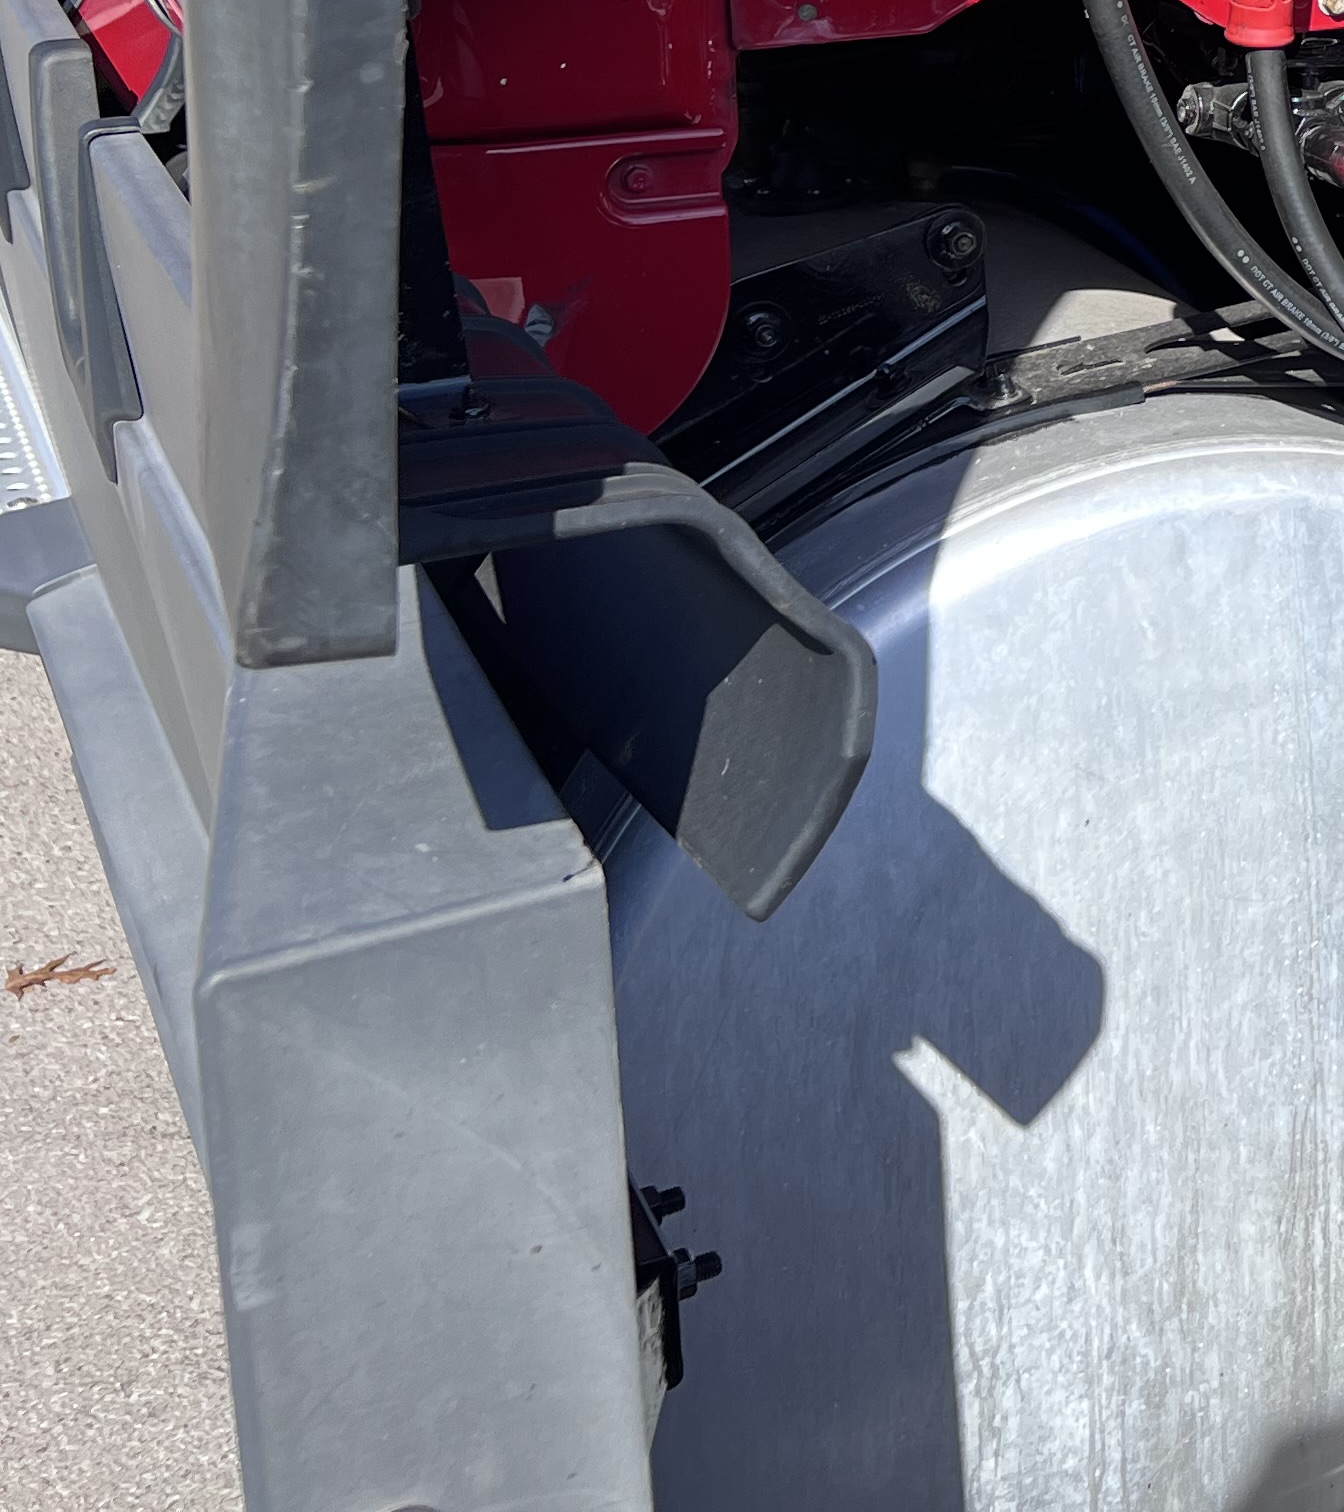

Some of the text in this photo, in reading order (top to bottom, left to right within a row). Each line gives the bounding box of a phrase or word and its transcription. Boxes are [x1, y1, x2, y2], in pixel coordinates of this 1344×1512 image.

[1126, 33, 1138, 49] CT
[1130, 46, 1142, 63] AIR
[1136, 62, 1153, 94] BRAKE
[1169, 138, 1183, 156] SAE
[1301, 258, 1316, 275] DOT
[1312, 273, 1323, 288] CT
[1320, 287, 1332, 303] AIR
[1250, 265, 1266, 282] DOT
[1262, 279, 1275, 291] CT
[1270, 288, 1285, 303] AIR
[1280, 298, 1306, 322] BRAKE
[1302, 317, 1323, 336] 10mm
